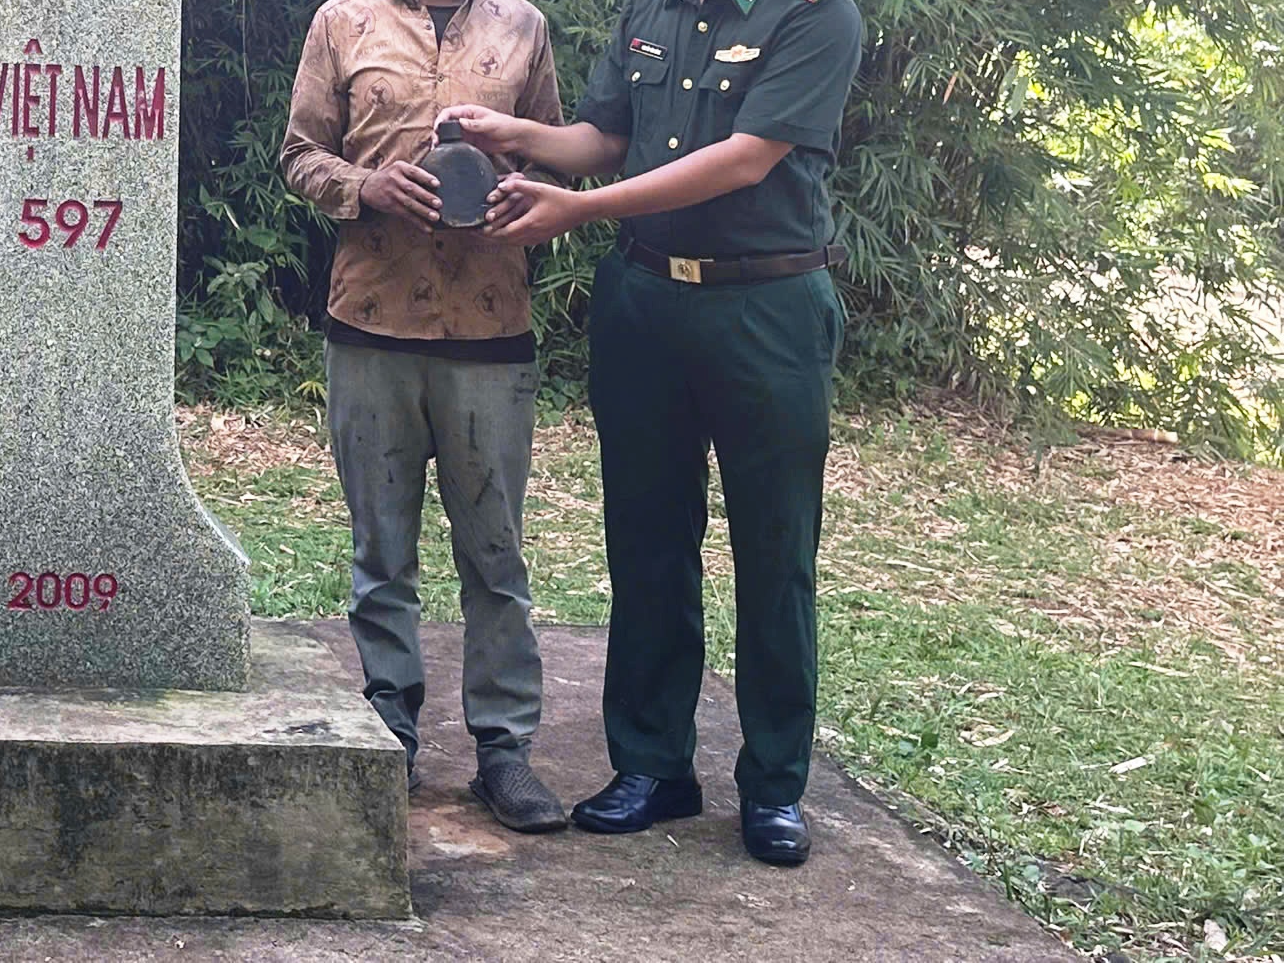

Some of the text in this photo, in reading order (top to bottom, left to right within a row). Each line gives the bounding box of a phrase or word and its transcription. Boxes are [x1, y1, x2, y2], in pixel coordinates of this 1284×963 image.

[73, 64, 166, 140] NAM
[18, 198, 123, 250] 597
[7, 571, 118, 611] 2009
